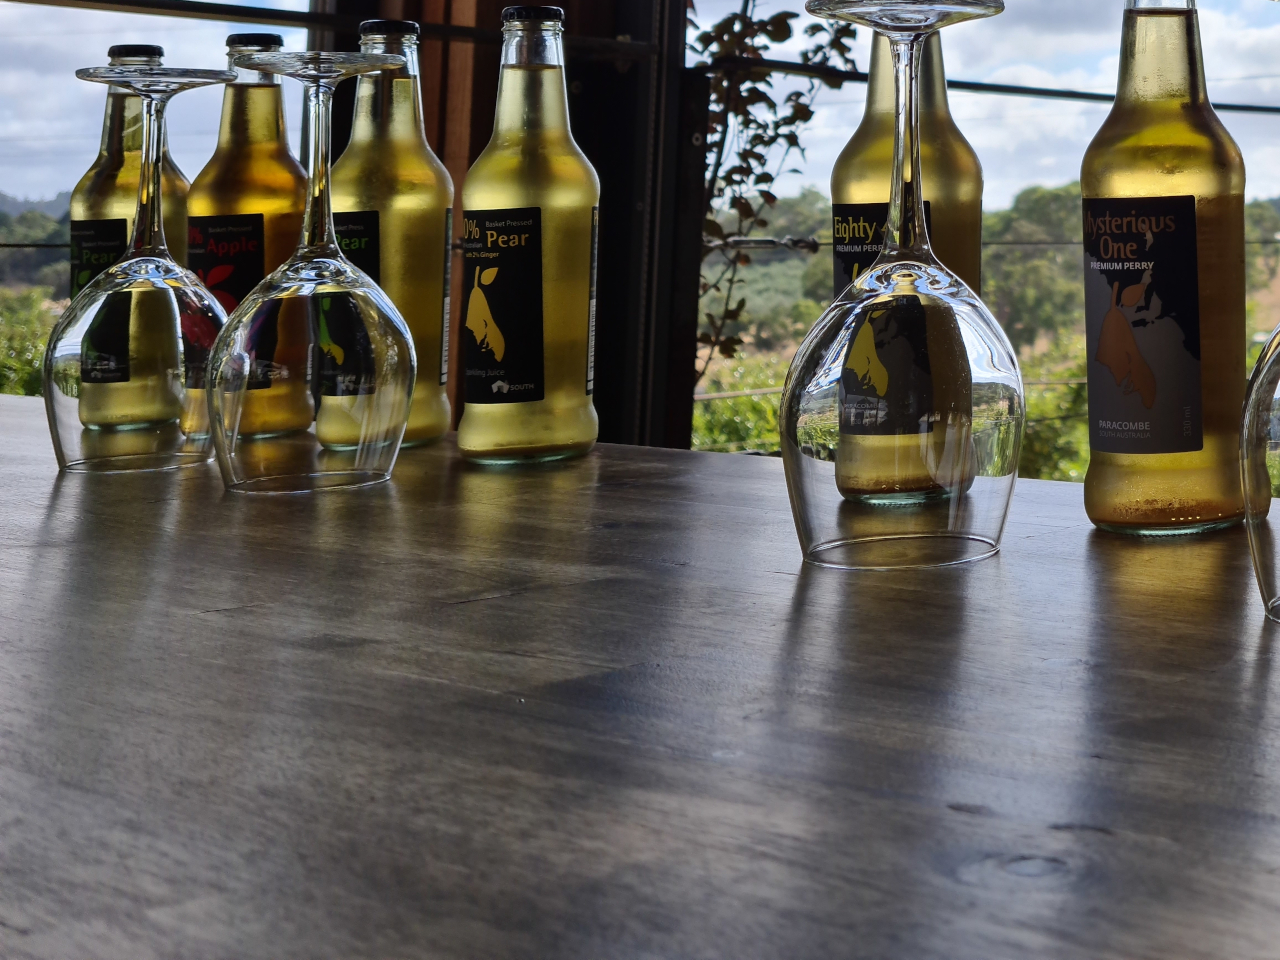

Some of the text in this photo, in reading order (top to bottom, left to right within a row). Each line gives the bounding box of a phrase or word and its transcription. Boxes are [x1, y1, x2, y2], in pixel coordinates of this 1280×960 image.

[506, 219, 533, 227] Pressed
[834, 216, 876, 244] Eighty
[486, 230, 529, 248] Pear
[207, 236, 258, 257] Apple
[836, 244, 883, 252] PREMIUM PERR
[1100, 236, 1138, 259] One
[82, 249, 117, 264] Pear
[480, 251, 500, 259] Ginger
[1090, 262, 1154, 270] PREMIUM PERRY
[487, 368, 505, 376] Juice
[510, 383, 534, 391] SOUTH
[1099, 420, 1150, 431] PARACOMBE
[1183, 419, 1192, 437] 330
[1099, 430, 1151, 439] SOUTH AUSTRALIA
